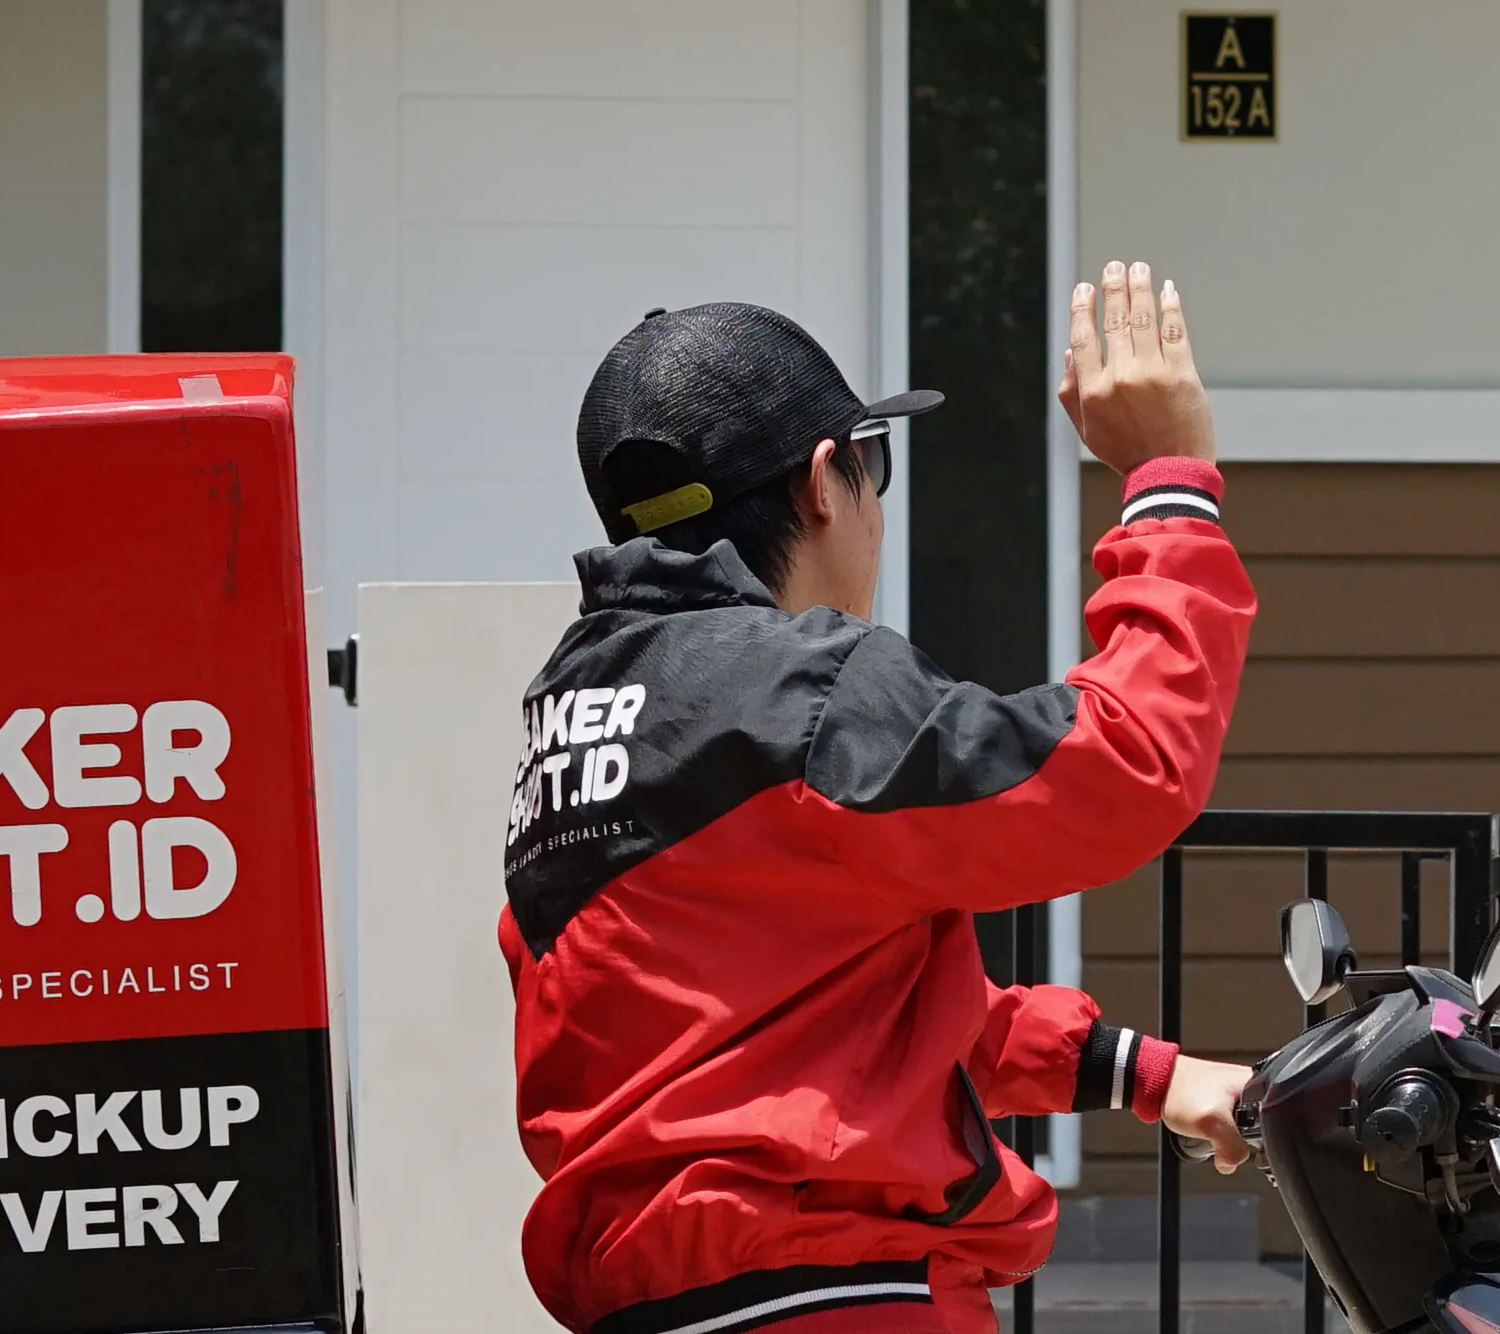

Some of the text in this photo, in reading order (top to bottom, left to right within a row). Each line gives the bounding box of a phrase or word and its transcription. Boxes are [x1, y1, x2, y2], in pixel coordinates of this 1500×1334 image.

[1215, 26, 1246, 69] A
[1191, 85, 1270, 128] 152 A
[547, 820, 634, 850] SPECIALIST
